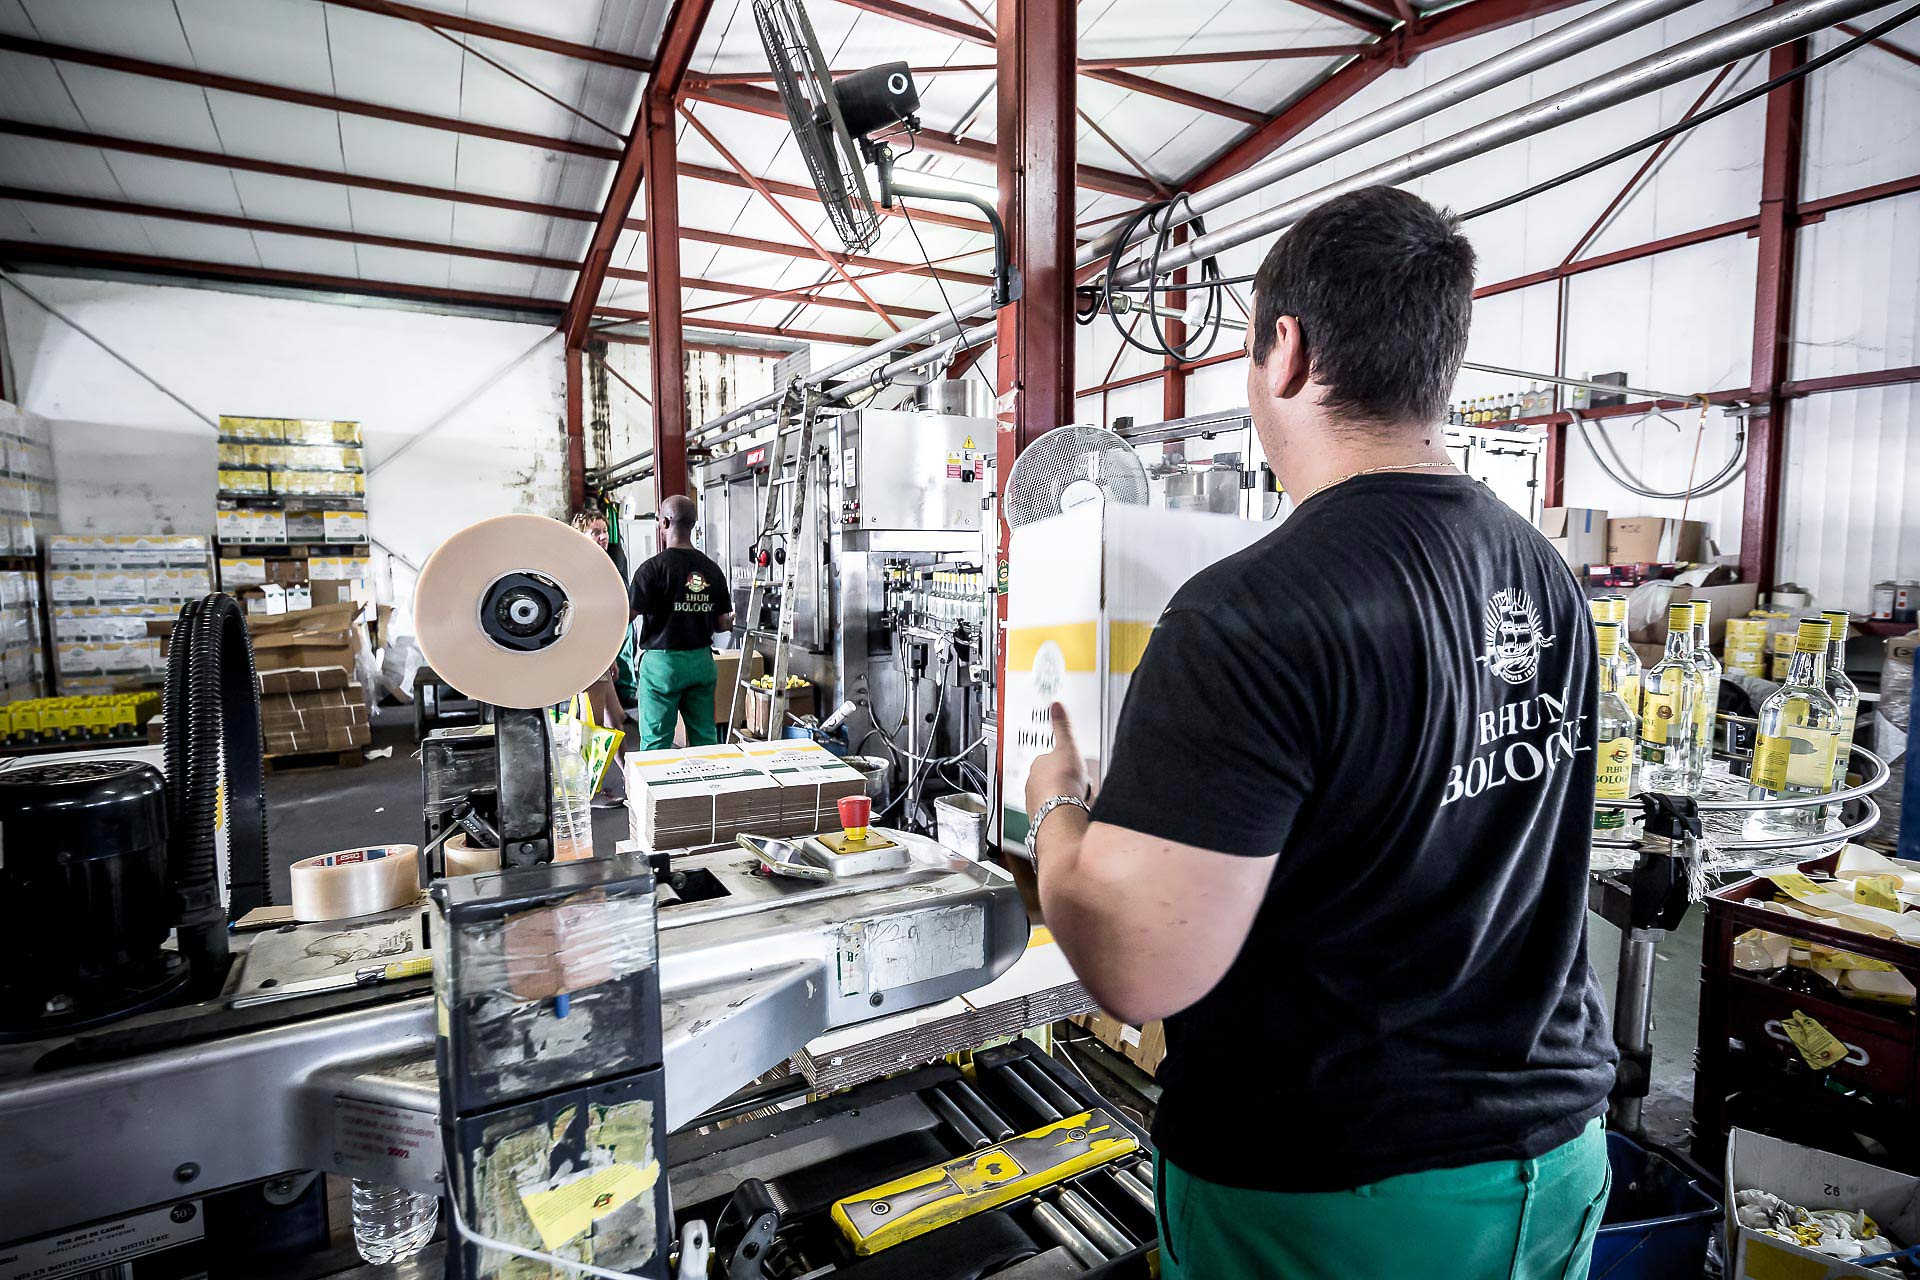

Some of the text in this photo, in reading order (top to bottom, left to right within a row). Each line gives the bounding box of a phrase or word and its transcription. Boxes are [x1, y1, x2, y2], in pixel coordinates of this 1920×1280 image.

[1479, 687, 1569, 746] RHUM
[33, 1268, 46, 1277] EN
[48, 1253, 98, 1272] BOUTEILLE
[108, 1248, 119, 1256] LA
[120, 1233, 170, 1252] DISTILLERIE
[57, 1224, 125, 1246] PUR JUS DE CANNE
